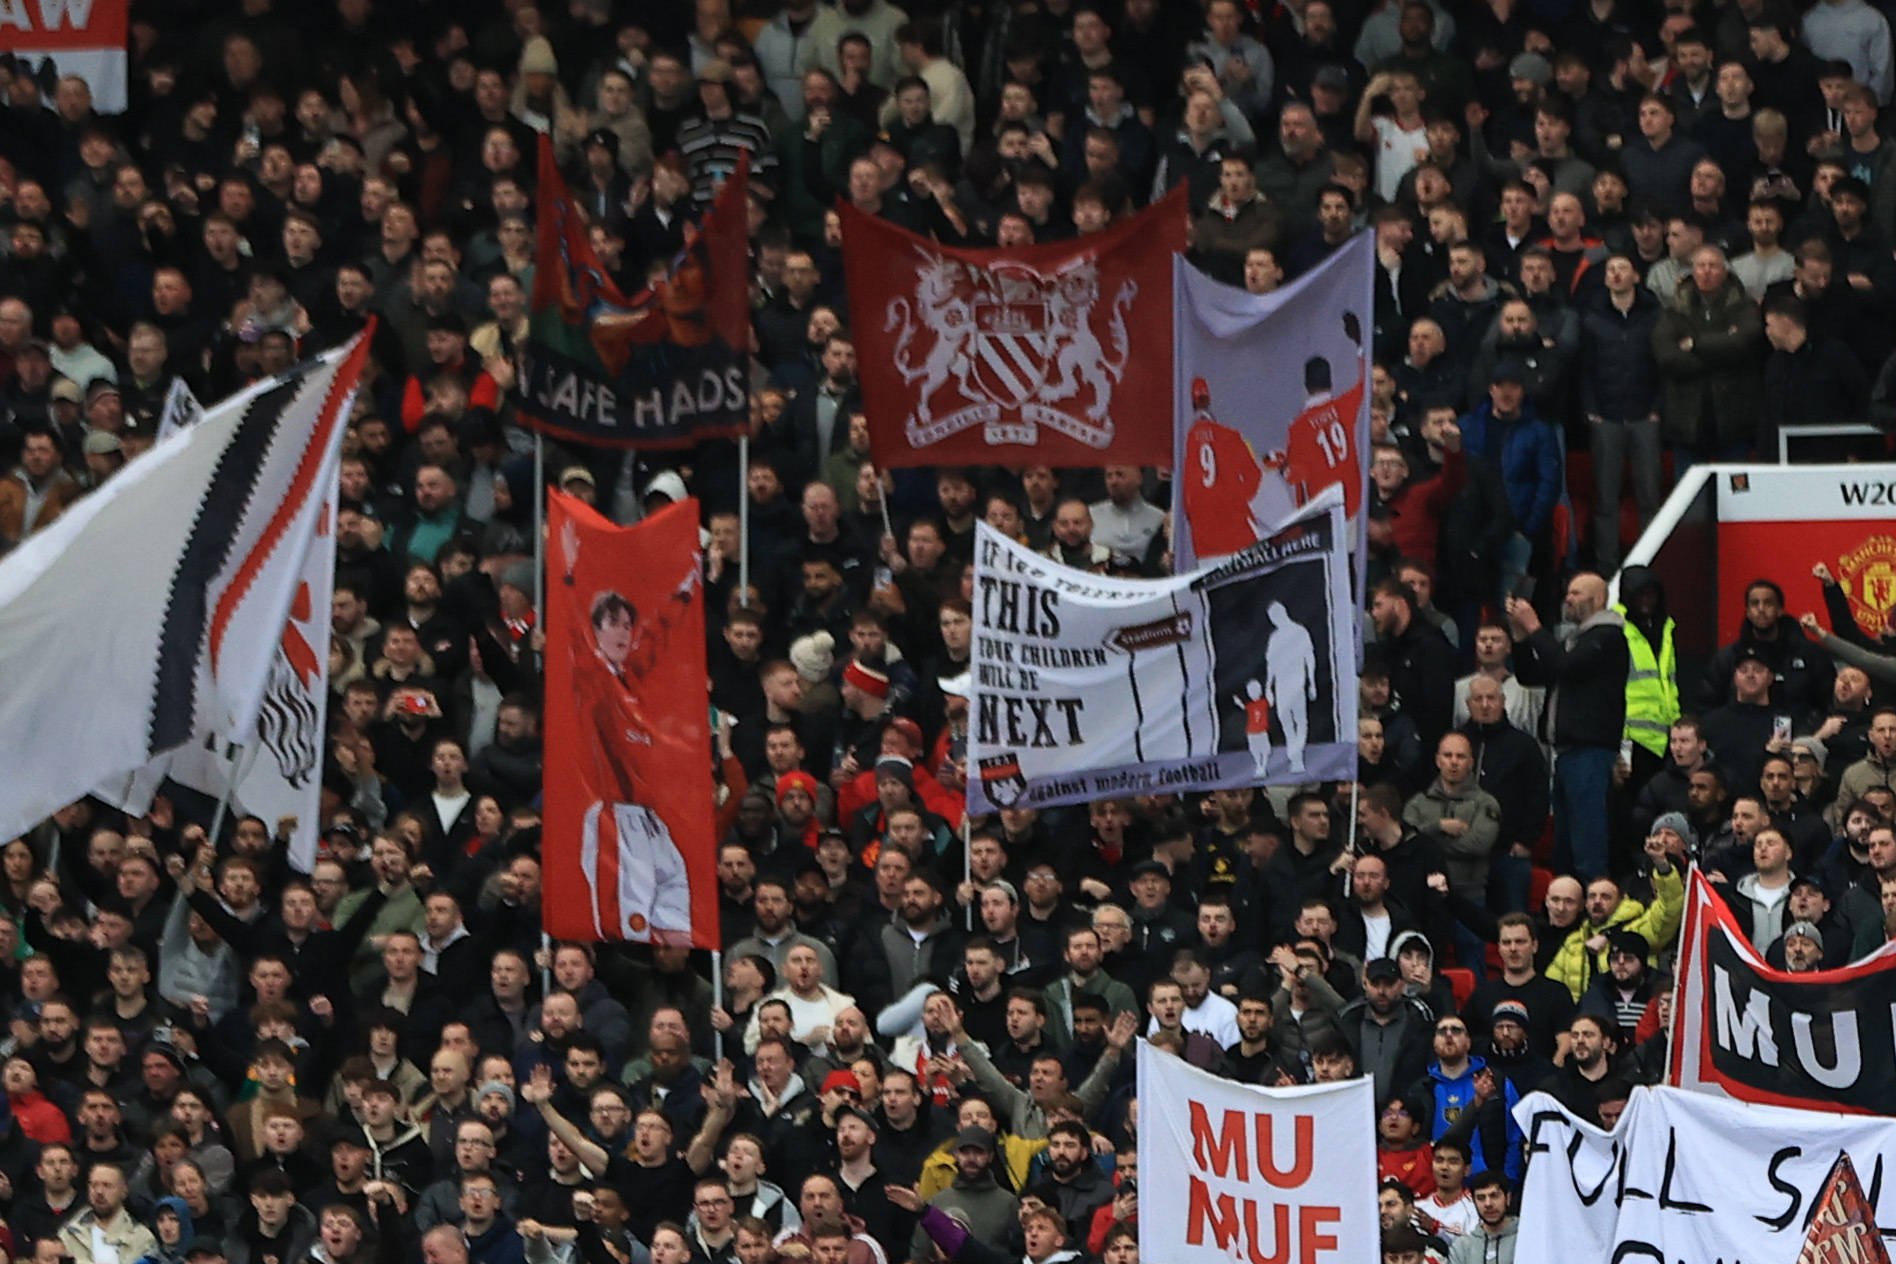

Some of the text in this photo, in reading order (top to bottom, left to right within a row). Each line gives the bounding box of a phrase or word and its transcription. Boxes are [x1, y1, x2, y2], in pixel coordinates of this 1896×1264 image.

[1200, 443, 1216, 489] 9
[1316, 421, 1348, 469] 19
[979, 575, 1061, 641] THIS
[1020, 643, 1108, 668] CHILDREN
[977, 693, 1085, 748] NEXT
[1188, 1099, 1315, 1190] MU
